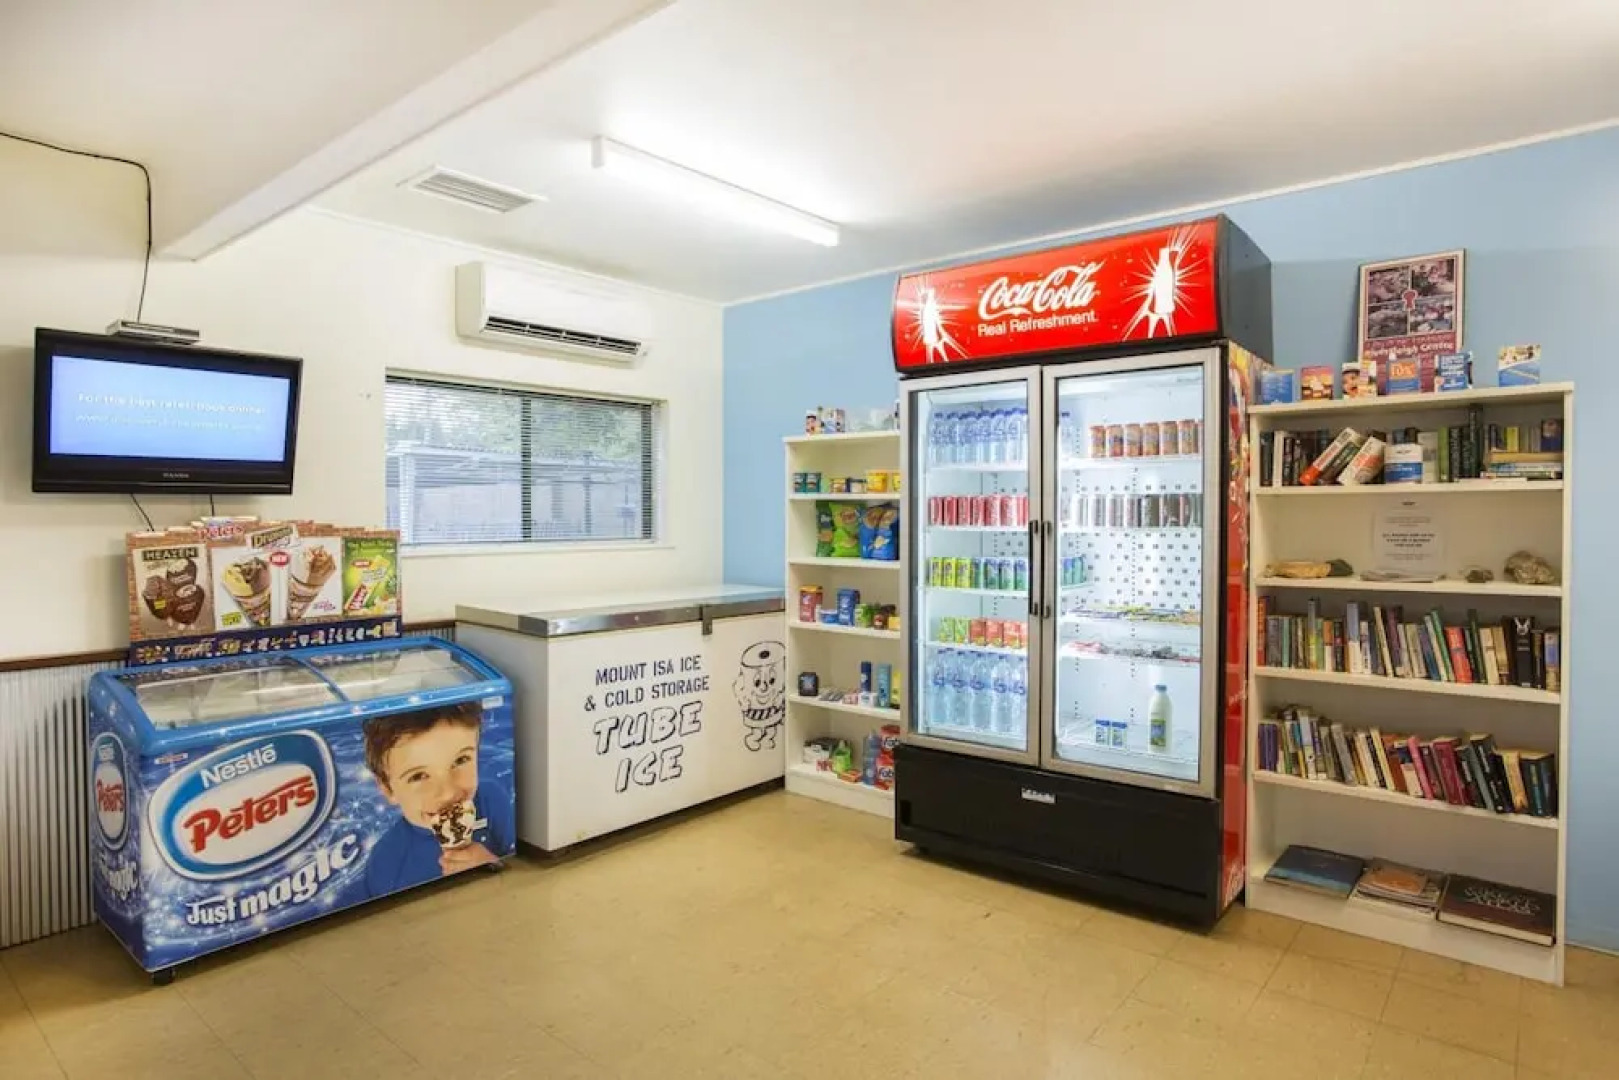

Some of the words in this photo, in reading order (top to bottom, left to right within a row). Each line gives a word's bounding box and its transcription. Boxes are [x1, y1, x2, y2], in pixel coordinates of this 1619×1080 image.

[978, 259, 1105, 320] Coca-Cola
[978, 322, 1007, 337] Real
[584, 695, 597, 712] &
[604, 687, 644, 708] COLD
[651, 675, 710, 699] STORAGE
[595, 662, 647, 686] MOUNT
[653, 659, 674, 677] ISA
[680, 654, 702, 673] ICE
[593, 700, 703, 755] TUBE
[615, 744, 684, 793] ICE
[183, 775, 316, 853] Peters
[186, 894, 238, 925] Just
[240, 833, 360, 917] magic
